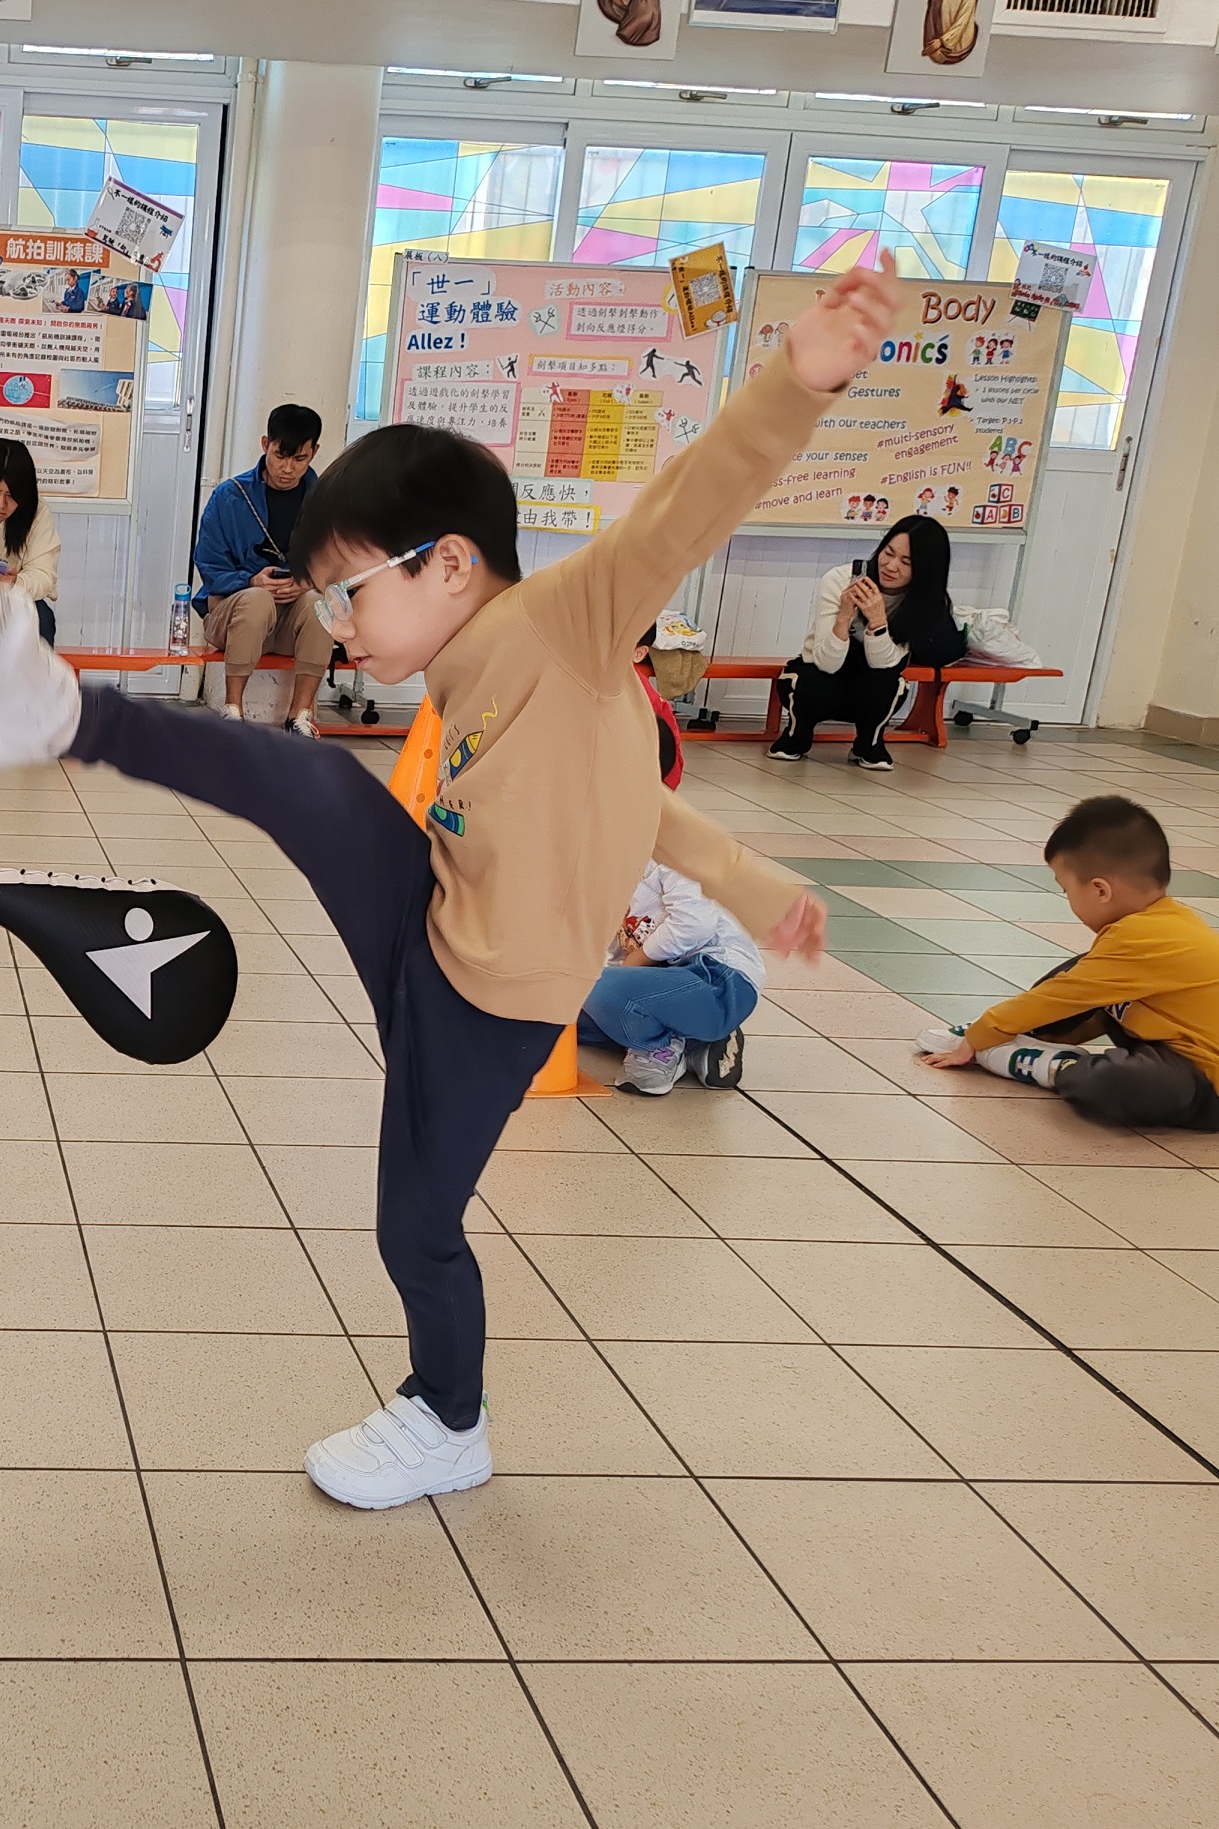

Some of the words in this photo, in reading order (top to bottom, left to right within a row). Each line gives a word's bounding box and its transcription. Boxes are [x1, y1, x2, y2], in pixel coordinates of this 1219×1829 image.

[6, 238, 103, 263] 航拍訓練課
[412, 271, 490, 295] 「世一」
[418, 300, 519, 324] 運動體驗
[921, 291, 996, 325] Body
[880, 332, 949, 365] onics
[974, 374, 1000, 382] Lesson
[848, 386, 901, 399] Gestures
[838, 419, 857, 428] our
[859, 419, 907, 430] teachers
[876, 423, 955, 449] #multi-sensory
[805, 452, 830, 463] your
[833, 452, 868, 462] senses
[894, 435, 959, 460] engagement
[813, 467, 856, 481] learning
[880, 469, 926, 486] #English
[930, 466, 938, 477] is
[941, 460, 972, 476] FUN!!
[754, 495, 790, 511] #move
[792, 491, 813, 504] and
[815, 487, 843, 501] learn
[1002, 488, 1010, 499] C
[986, 509, 994, 521] A
[1012, 507, 1020, 519] B
[652, 1047, 675, 1064] N
